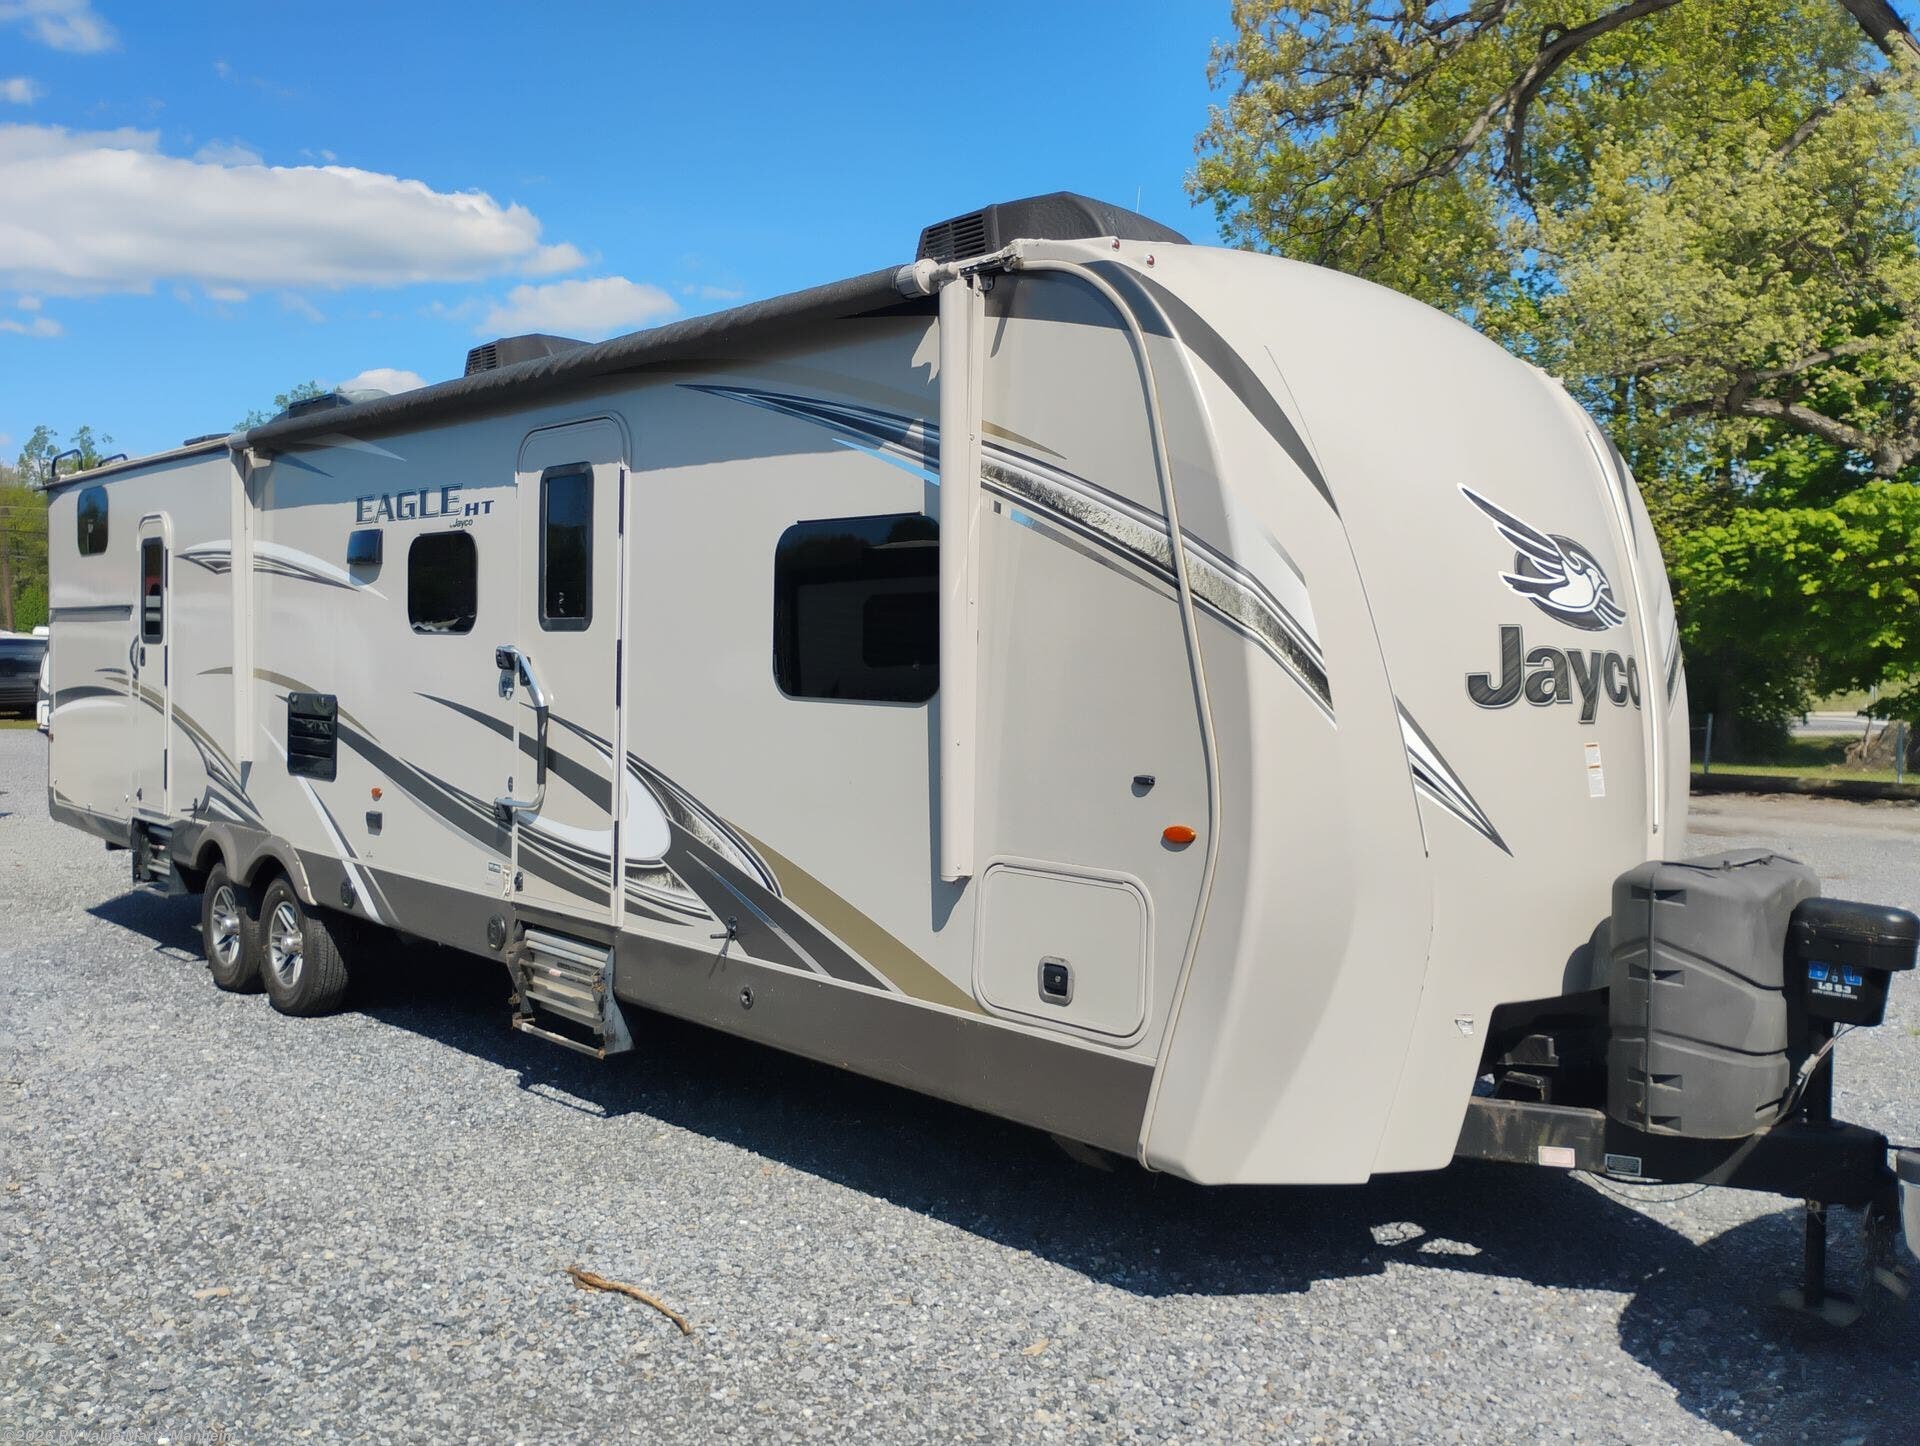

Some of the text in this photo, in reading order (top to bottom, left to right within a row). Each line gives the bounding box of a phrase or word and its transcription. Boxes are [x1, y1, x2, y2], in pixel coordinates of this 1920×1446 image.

[356, 483, 494, 525] EAGLE HT
[453, 518, 474, 528] Jayco
[1465, 623, 1642, 725] Jayco
